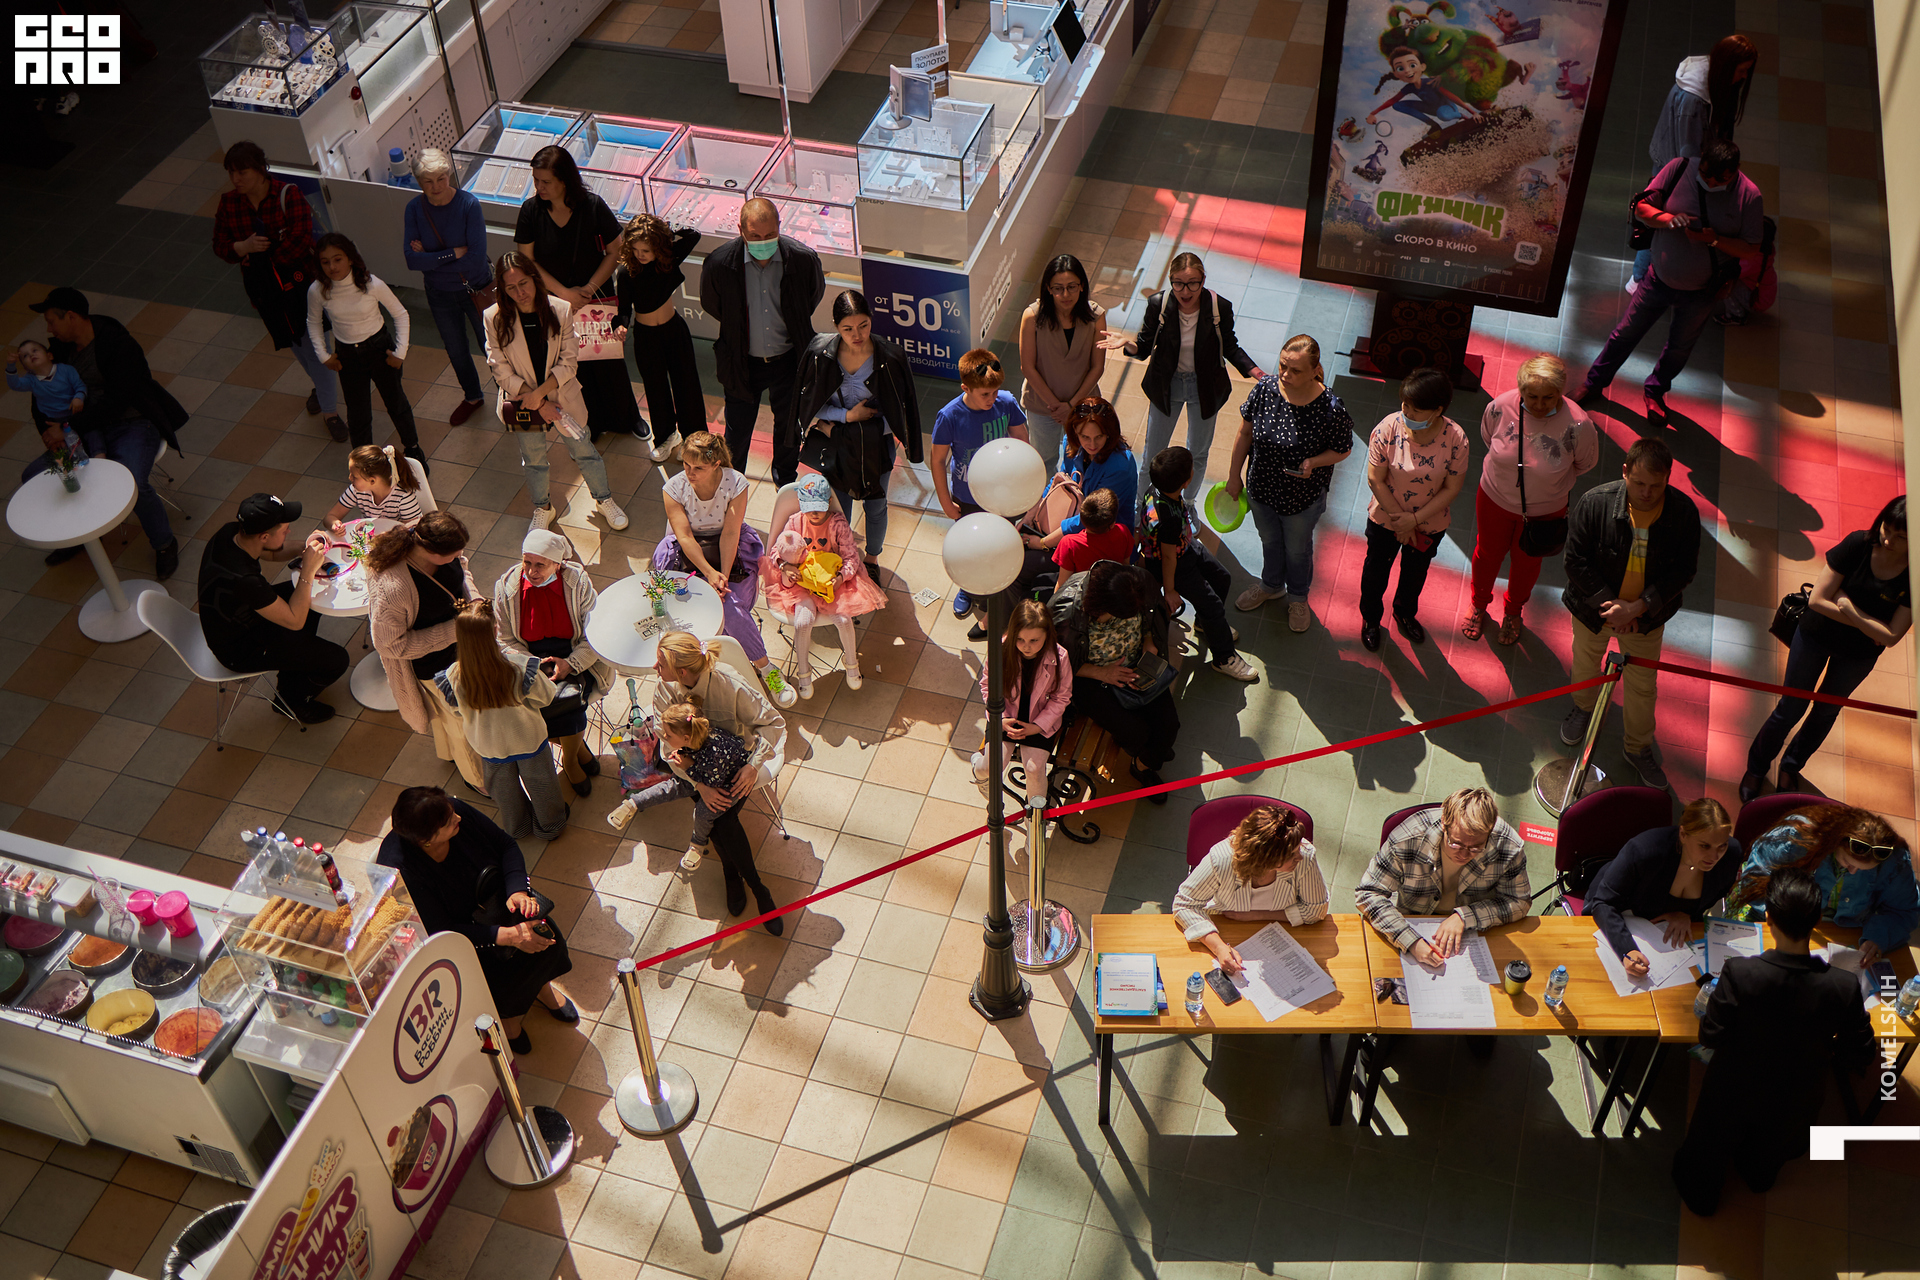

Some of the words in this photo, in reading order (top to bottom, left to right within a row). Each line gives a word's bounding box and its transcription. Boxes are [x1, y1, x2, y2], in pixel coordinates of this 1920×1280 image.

[915, 50, 946, 62] ПОКУПАЕМ
[916, 56, 946, 68] ЗОЛОТО
[1377, 191, 1505, 239] ФИННИК
[1394, 234, 1434, 246] СКОРО
[1436, 239, 1443, 247] В
[1446, 241, 1477, 253] КИНО
[1320, 254, 1345, 269] ДЛЯ
[1355, 258, 1425, 280] ЗРИТЕЛЕЙ
[1435, 270, 1488, 291] СТАРШЕ
[1517, 283, 1542, 299] ЛЕТ
[284, 1188, 350, 1280] ДНИК
